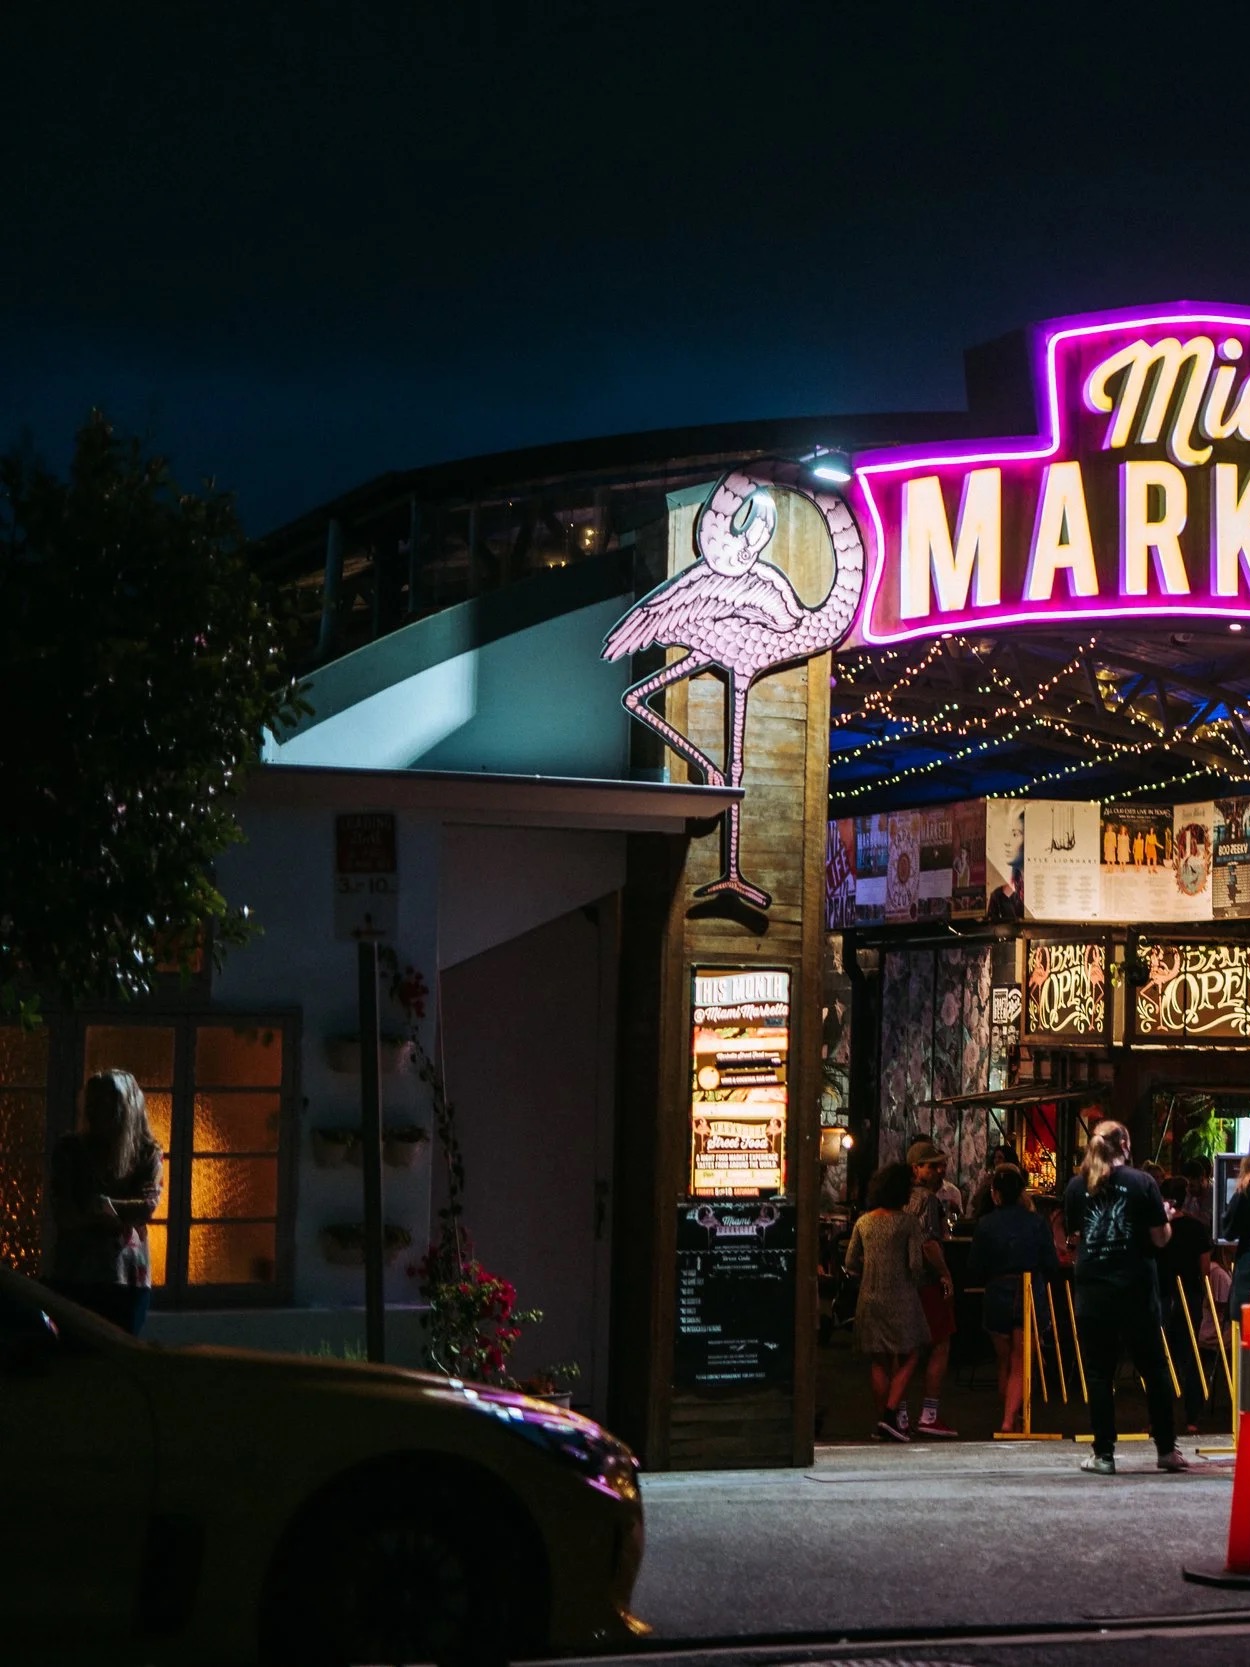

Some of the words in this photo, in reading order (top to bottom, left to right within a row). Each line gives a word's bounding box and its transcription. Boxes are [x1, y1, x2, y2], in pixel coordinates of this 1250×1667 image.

[1050, 945, 1086, 972] BAR
[1180, 945, 1249, 972] BAR
[695, 978, 727, 1003] THIS
[732, 975, 783, 1001] MONTH
[1039, 967, 1092, 1031] OPEN
